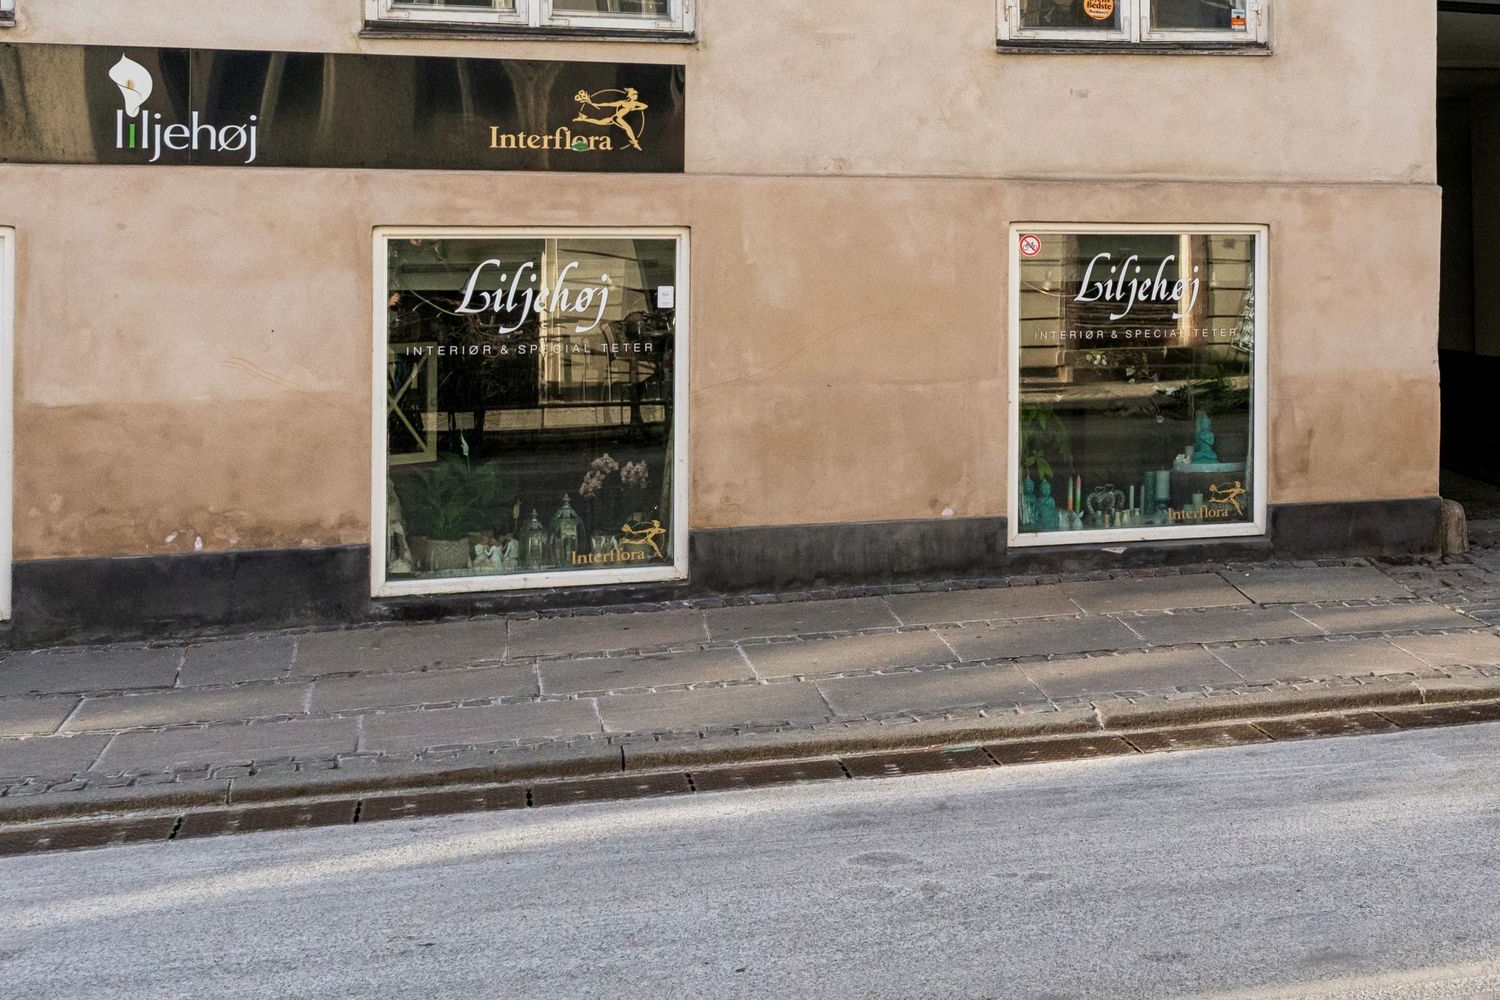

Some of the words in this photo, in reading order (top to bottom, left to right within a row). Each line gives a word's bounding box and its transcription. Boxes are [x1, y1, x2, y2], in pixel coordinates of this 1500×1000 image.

[489, 126, 614, 152] Interflora
[1073, 252, 1200, 321] Liljehøj
[455, 258, 611, 334] Liljehøj
[1034, 329, 1105, 340] INTERIØR
[1111, 330, 1118, 339] &
[406, 345, 492, 356] INTERIØR
[500, 345, 509, 355] &
[1168, 504, 1229, 520] Interflora
[571, 547, 645, 565] Interflora
